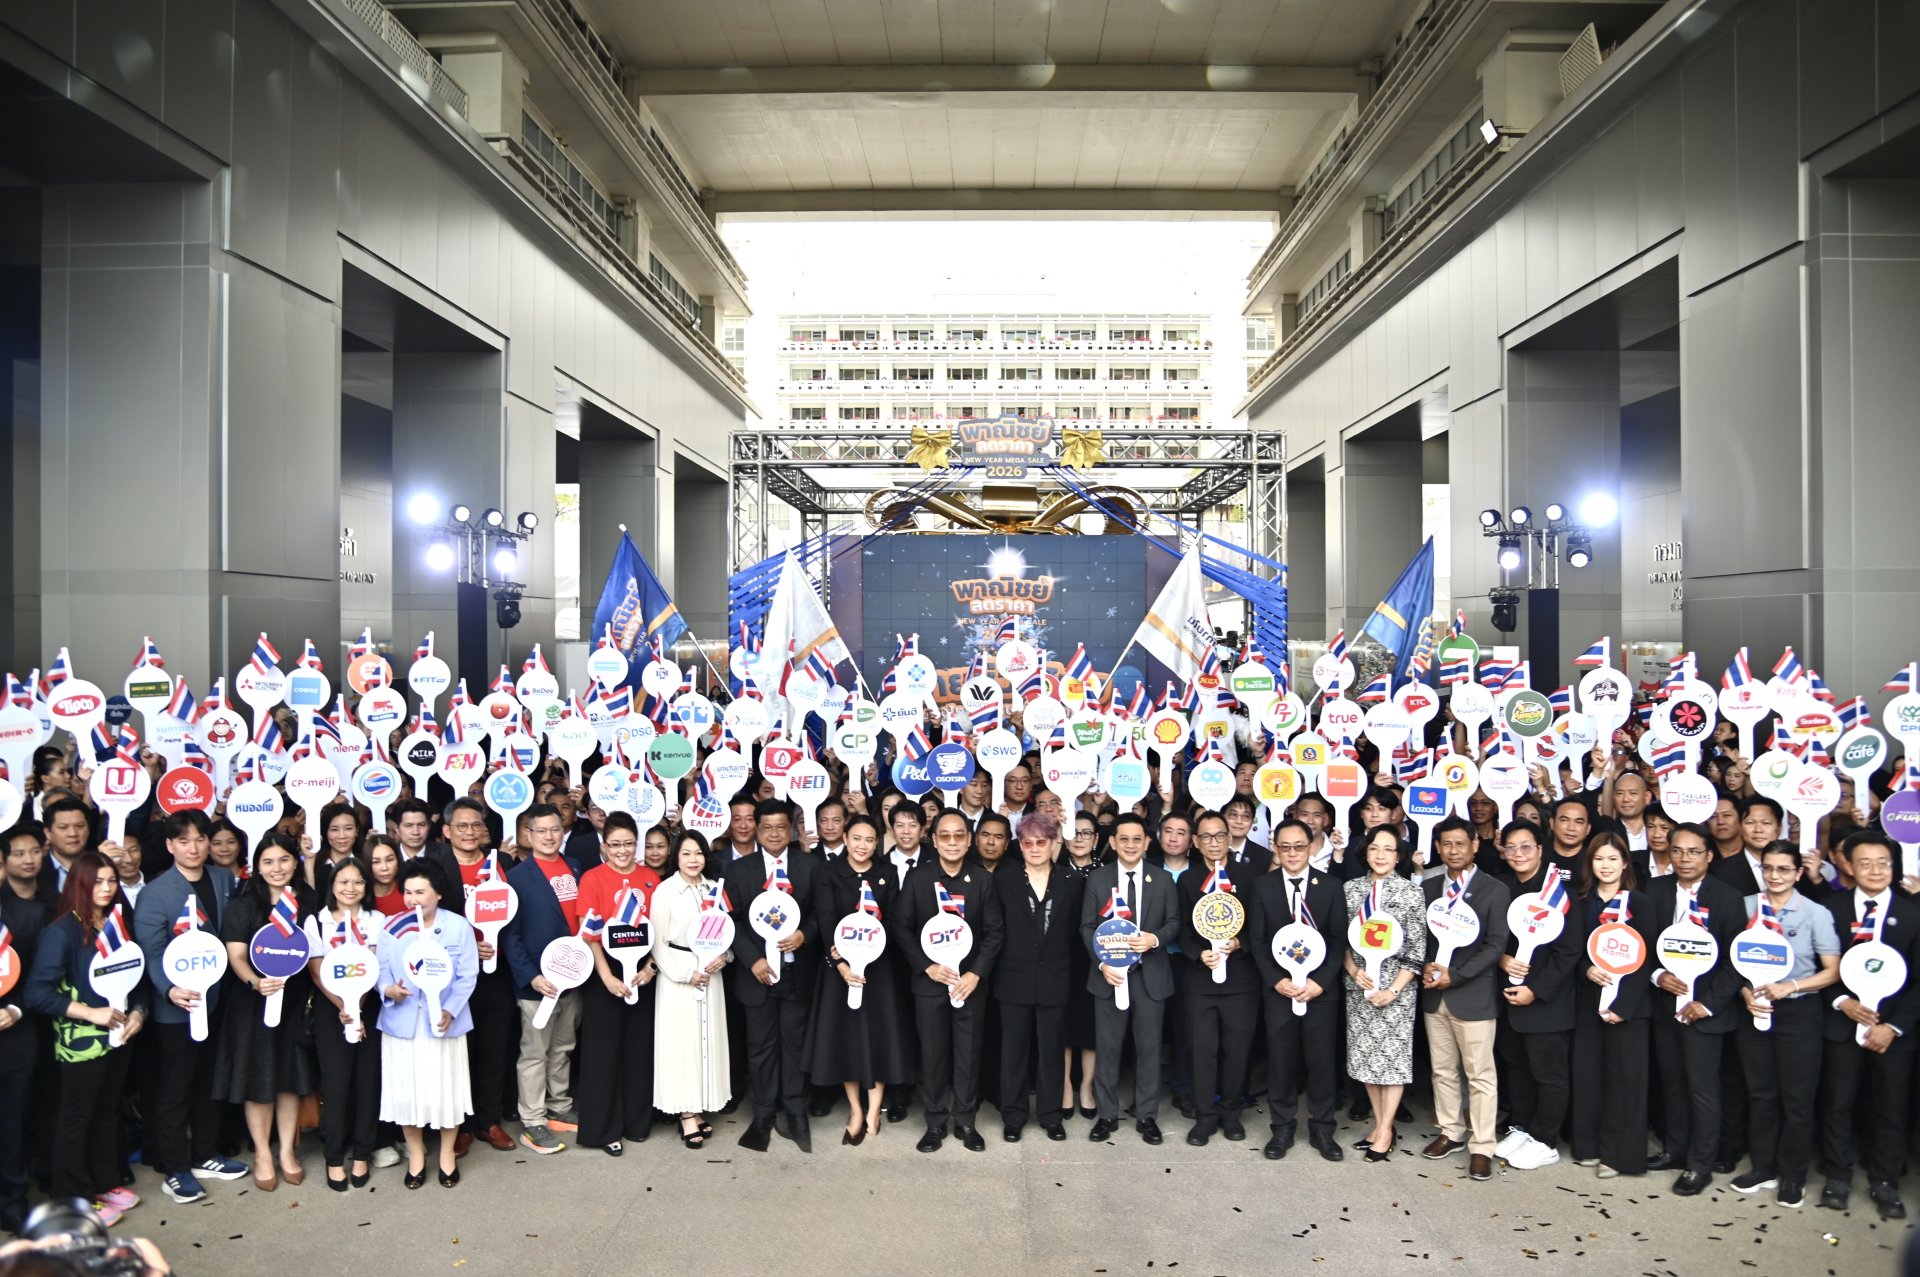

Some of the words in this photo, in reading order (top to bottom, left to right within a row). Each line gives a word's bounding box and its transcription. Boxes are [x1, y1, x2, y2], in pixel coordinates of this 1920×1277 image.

[961, 417, 1051, 441] พาณิชย์
[975, 440, 1036, 453] ลดราคา
[987, 466, 1023, 477] 2026
[953, 574, 1053, 600] พาณิชย์
[970, 599, 1036, 614] ลดราคา
[958, 617, 976, 625] NEW
[979, 617, 1000, 626] YEAR
[1776, 687, 1797, 697] King
[58, 698, 95, 715] Tipco
[1274, 703, 1291, 722] PT
[1328, 713, 1358, 724] true
[1800, 717, 1828, 725] Sunlee
[156, 725, 196, 734] SUNTORY
[631, 727, 653, 738] DSG
[841, 734, 869, 748] CP
[333, 745, 361, 753] nlene
[993, 746, 1017, 756] SWC
[1846, 745, 1875, 760] café
[716, 764, 746, 772] unicharm
[901, 764, 931, 781] P&G
[291, 777, 335, 788] CP-meiji
[790, 775, 825, 790] NEO
[235, 798, 274, 813] หนองโพ
[1411, 804, 1444, 814] Lazada
[690, 820, 722, 828] EARTH
[477, 900, 507, 911] Tops
[1432, 904, 1444, 912] CP
[1363, 921, 1378, 931] Big
[612, 931, 644, 939] CENTRAL
[1364, 927, 1389, 947] C
[1602, 948, 1631, 960] home
[175, 955, 218, 972] OFM
[334, 963, 367, 979] B2S
